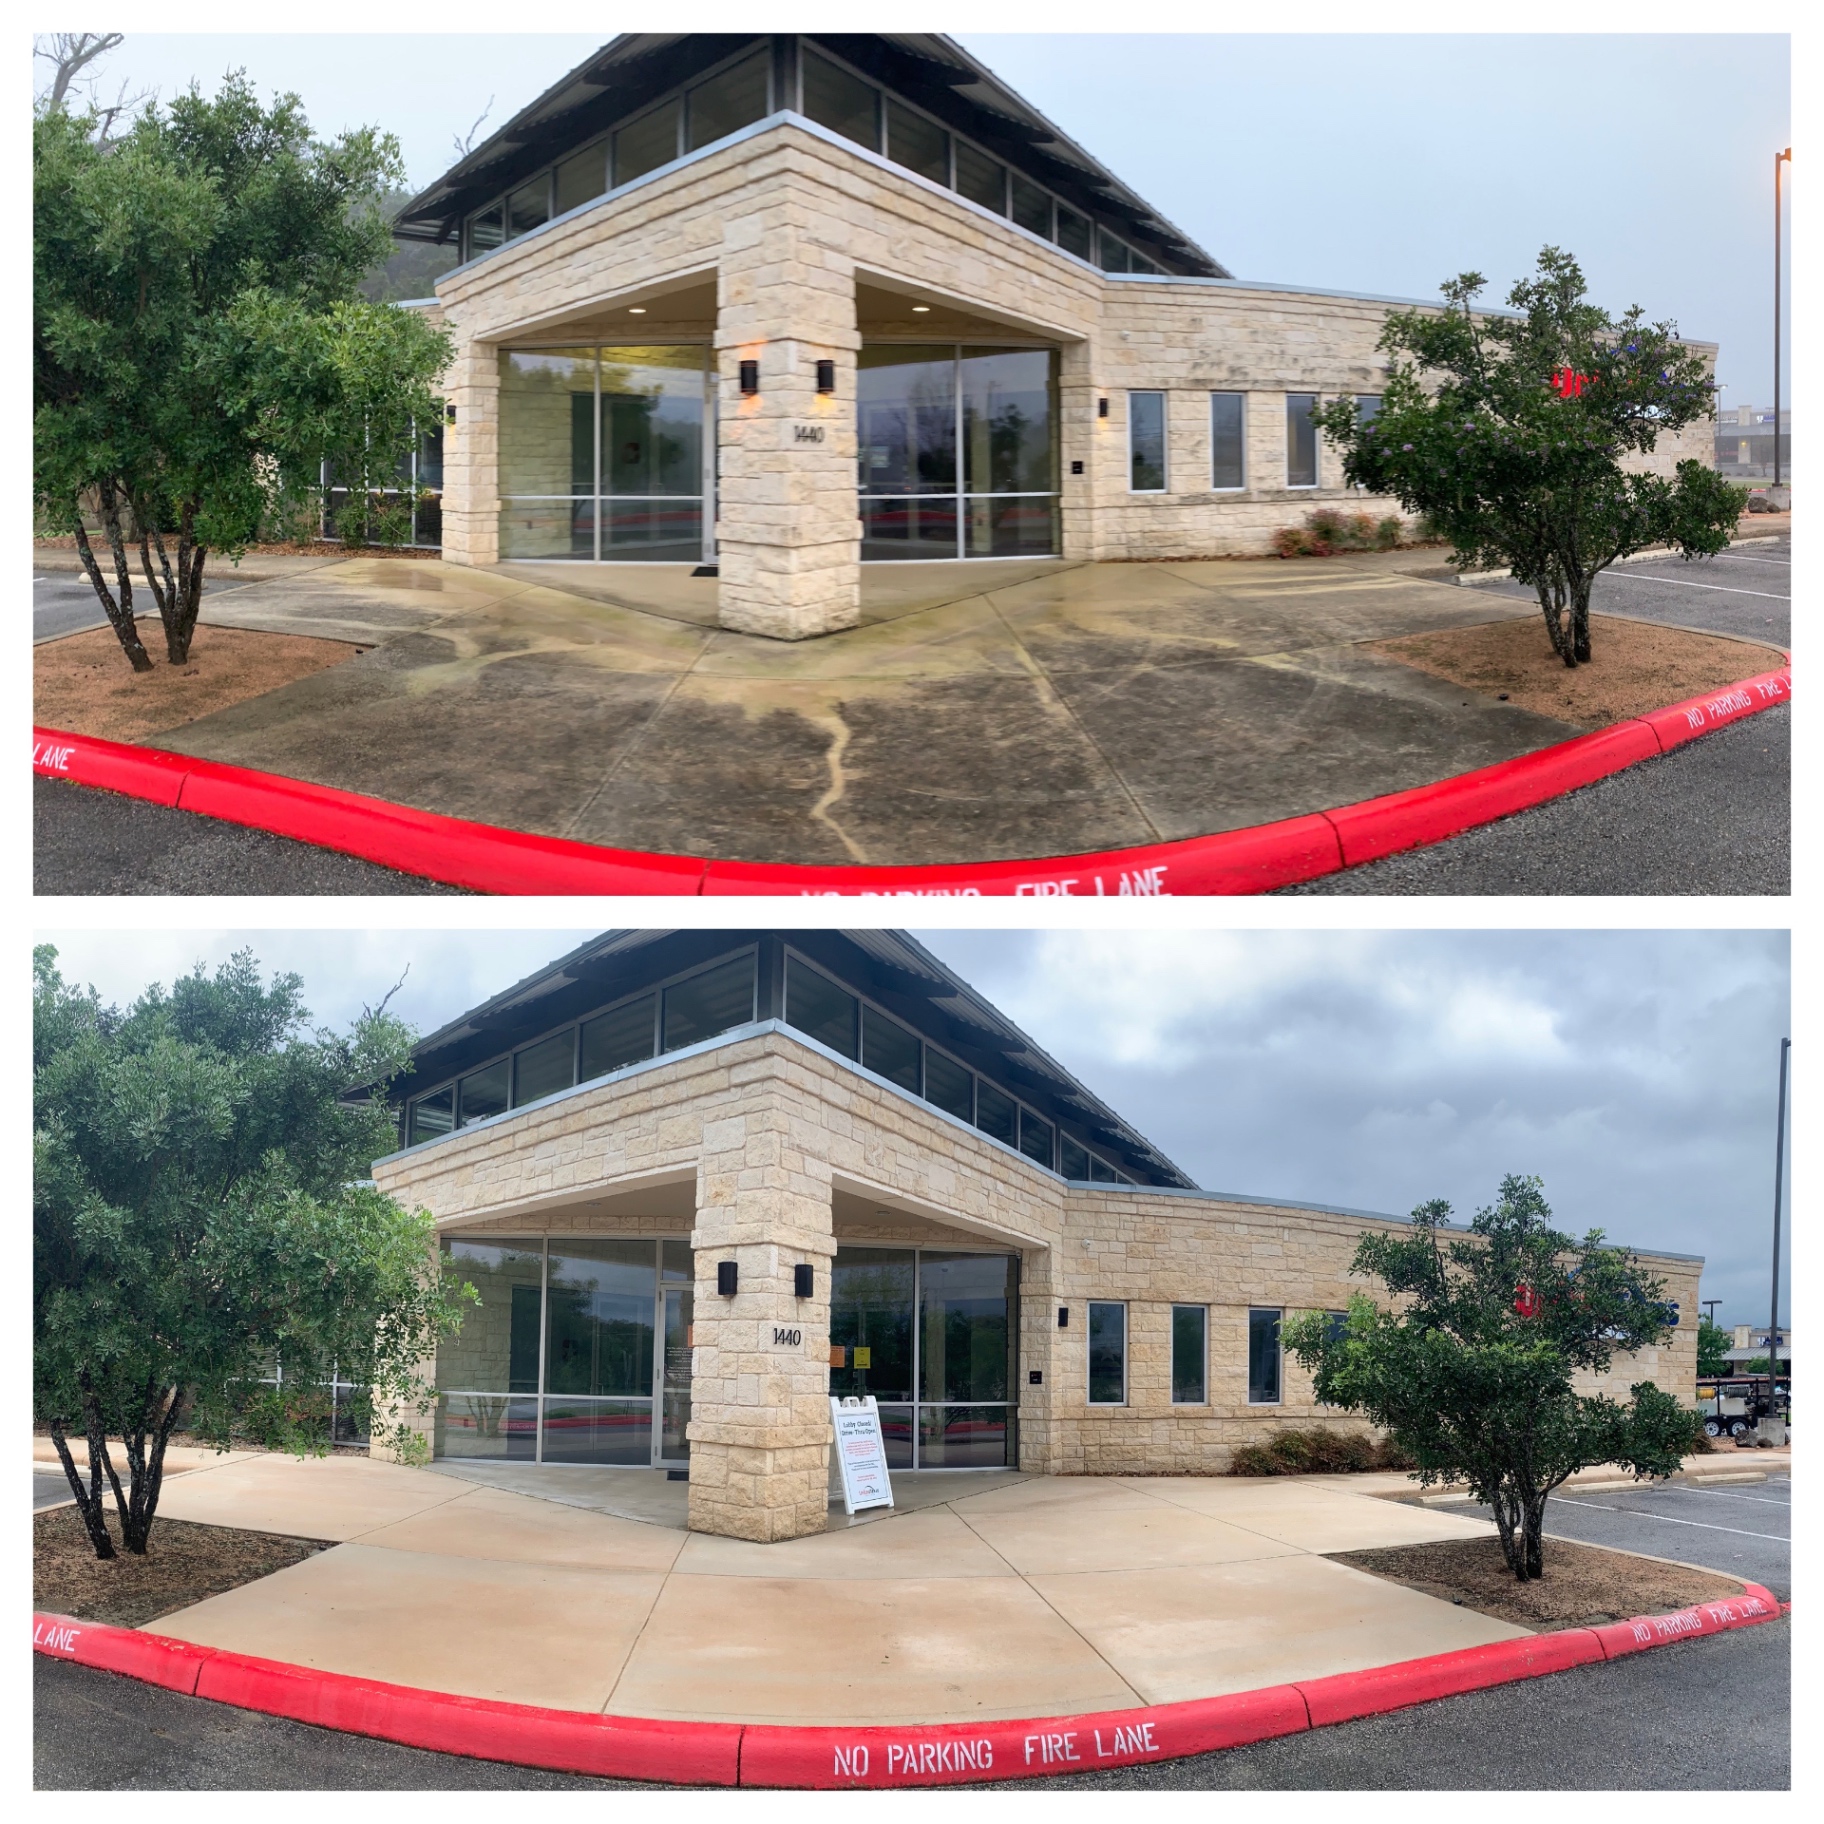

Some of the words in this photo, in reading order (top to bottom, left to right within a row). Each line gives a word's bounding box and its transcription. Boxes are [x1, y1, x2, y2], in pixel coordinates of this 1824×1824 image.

[794, 425, 825, 443] 1440
[1683, 707, 1705, 729] NO
[1706, 689, 1752, 720] PARKING
[1754, 678, 1782, 699] FIRE
[33, 742, 76, 770] LANE
[773, 1327, 801, 1346] 1440
[1631, 1623, 1651, 1643] NO
[1653, 1612, 1702, 1637] PARKING
[1708, 1605, 1737, 1624] FIRE
[1736, 1599, 1767, 1618] LANE
[33, 1623, 81, 1652] LANE
[834, 1745, 869, 1777] NO
[888, 1739, 993, 1774] PARKING
[1024, 1732, 1080, 1765] FIRE
[1094, 1722, 1160, 1757] LANE
